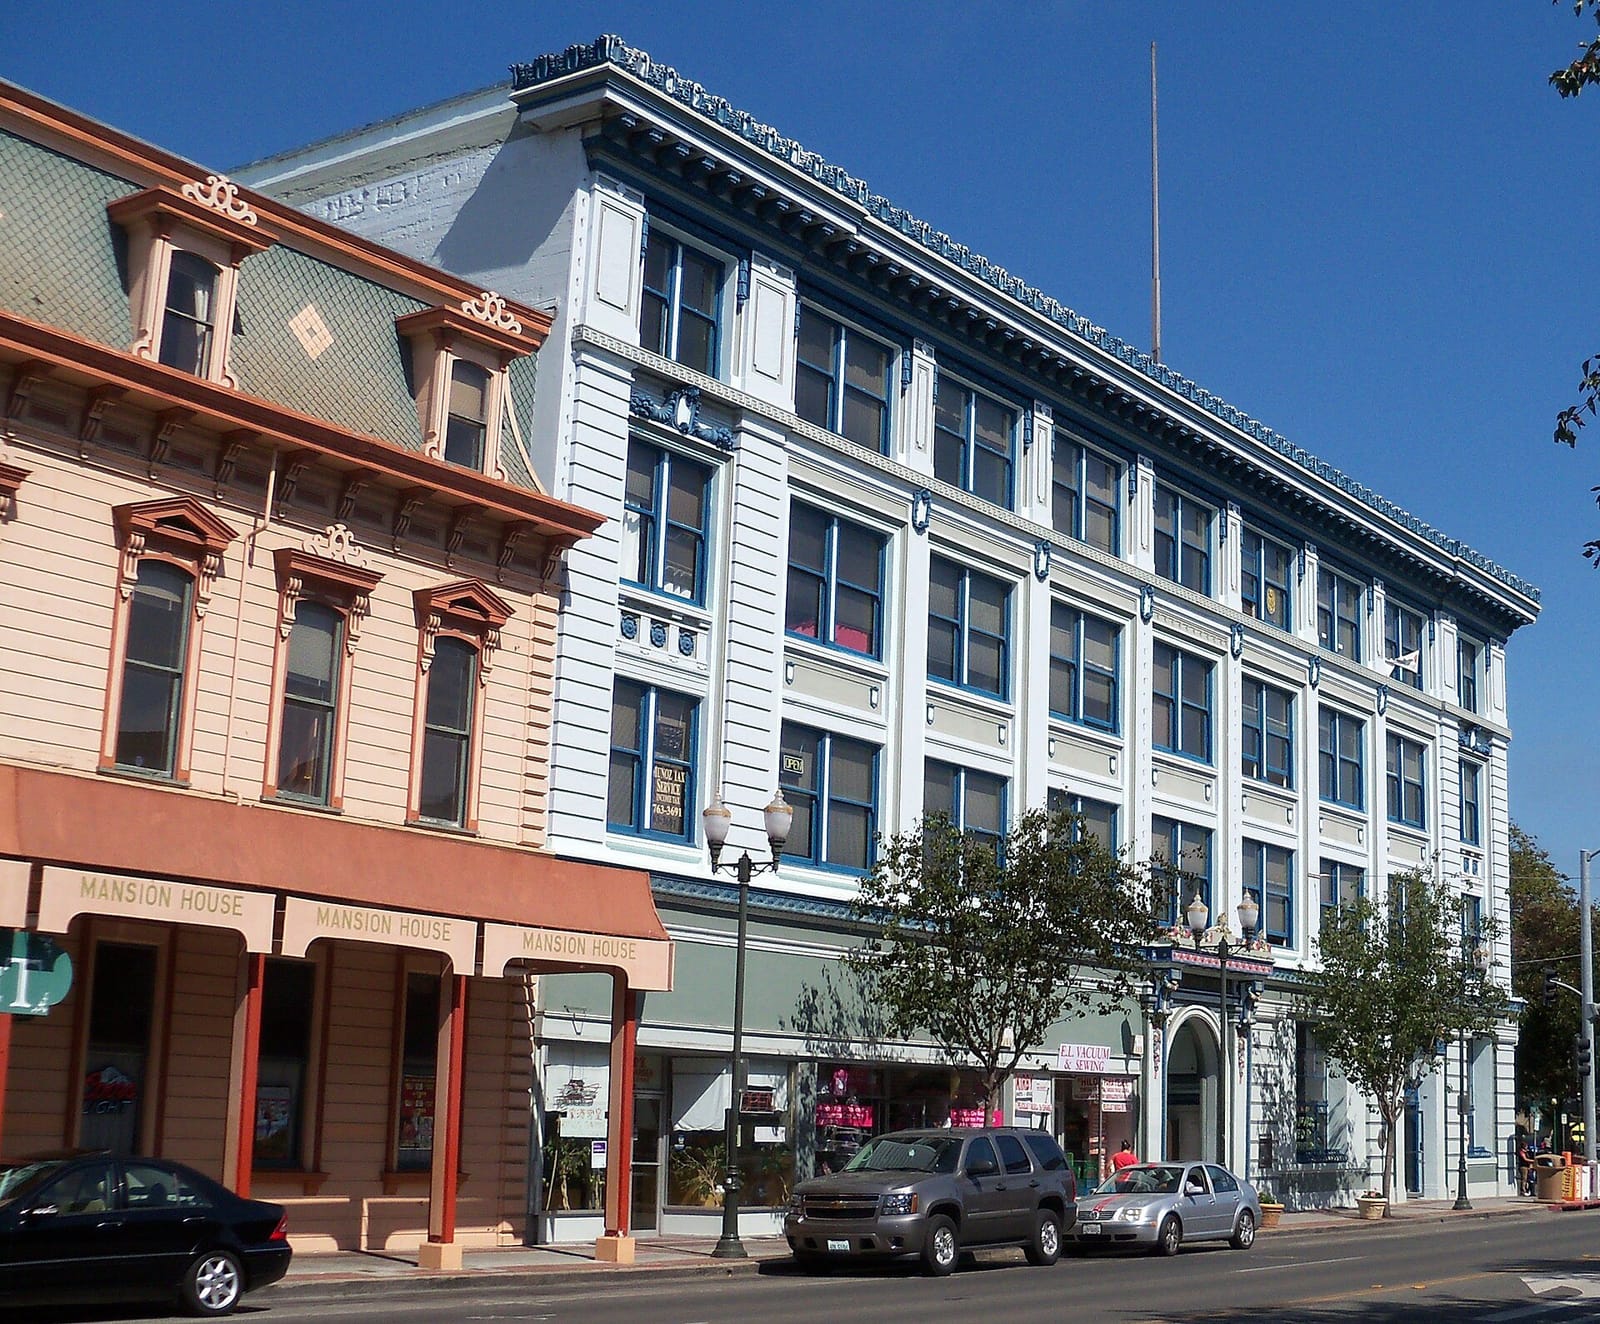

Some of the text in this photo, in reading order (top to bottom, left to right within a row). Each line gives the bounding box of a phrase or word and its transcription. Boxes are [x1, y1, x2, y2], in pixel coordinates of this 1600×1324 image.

[656, 779, 681, 795] SERVICE
[652, 804, 682, 817] 763-3691
[80, 876, 245, 916] MANSION HOUSE
[316, 907, 451, 941] MANSION HOUSE
[522, 932, 637, 960] MANSION HOUSE
[1076, 1046, 1110, 1060] VACUUM
[1063, 1059, 1105, 1072] & SEWING
